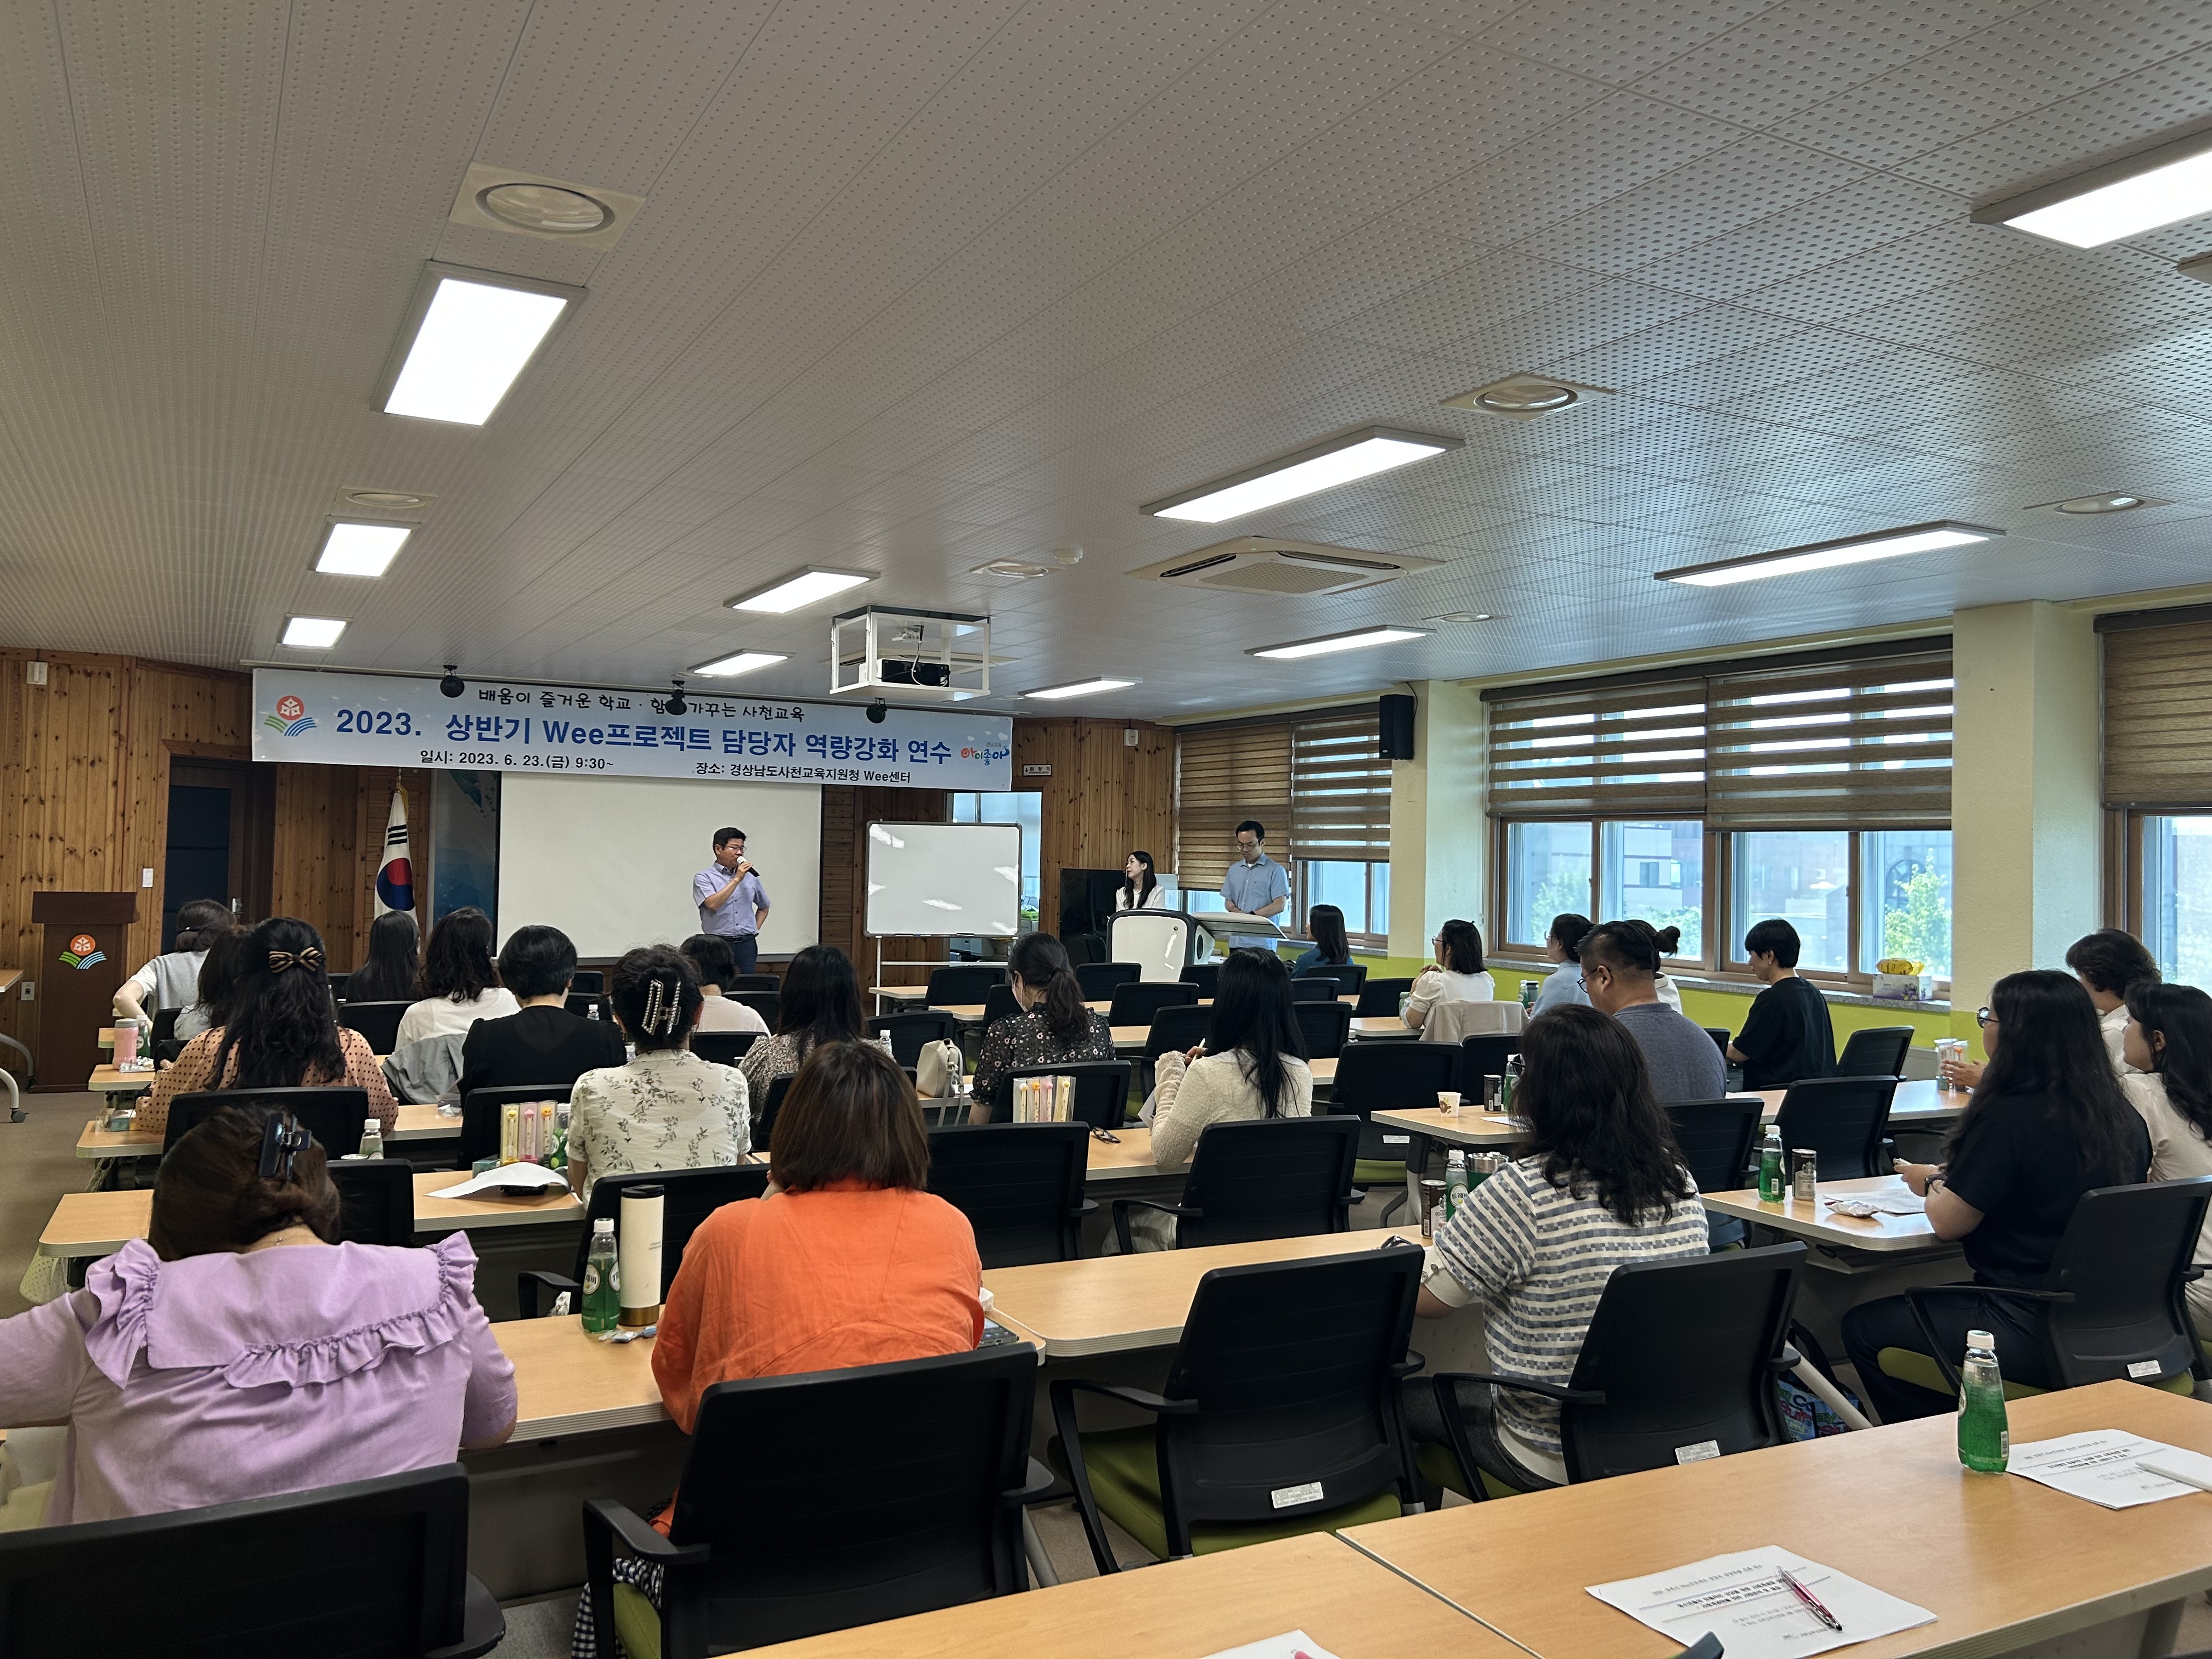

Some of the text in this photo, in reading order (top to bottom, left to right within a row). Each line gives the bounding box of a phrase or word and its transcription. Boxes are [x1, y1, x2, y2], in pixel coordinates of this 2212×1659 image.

[478, 687, 531, 705] 배움이
[539, 691, 591, 709] 즐거운
[598, 694, 631, 711] 학교
[688, 702, 737, 718] 가꾸는
[742, 704, 805, 723] 사천교육
[336, 709, 952, 765] 2023. 상반기 Wee프로젝트 담당자 역량강화 연수
[420, 750, 453, 764] 일시:
[459, 752, 499, 765] 2023.
[504, 754, 517, 766] 6.
[575, 757, 614, 769] 9:30~
[696, 762, 911, 783] 장소: 경상남도사천교육지원청 Wee센터
